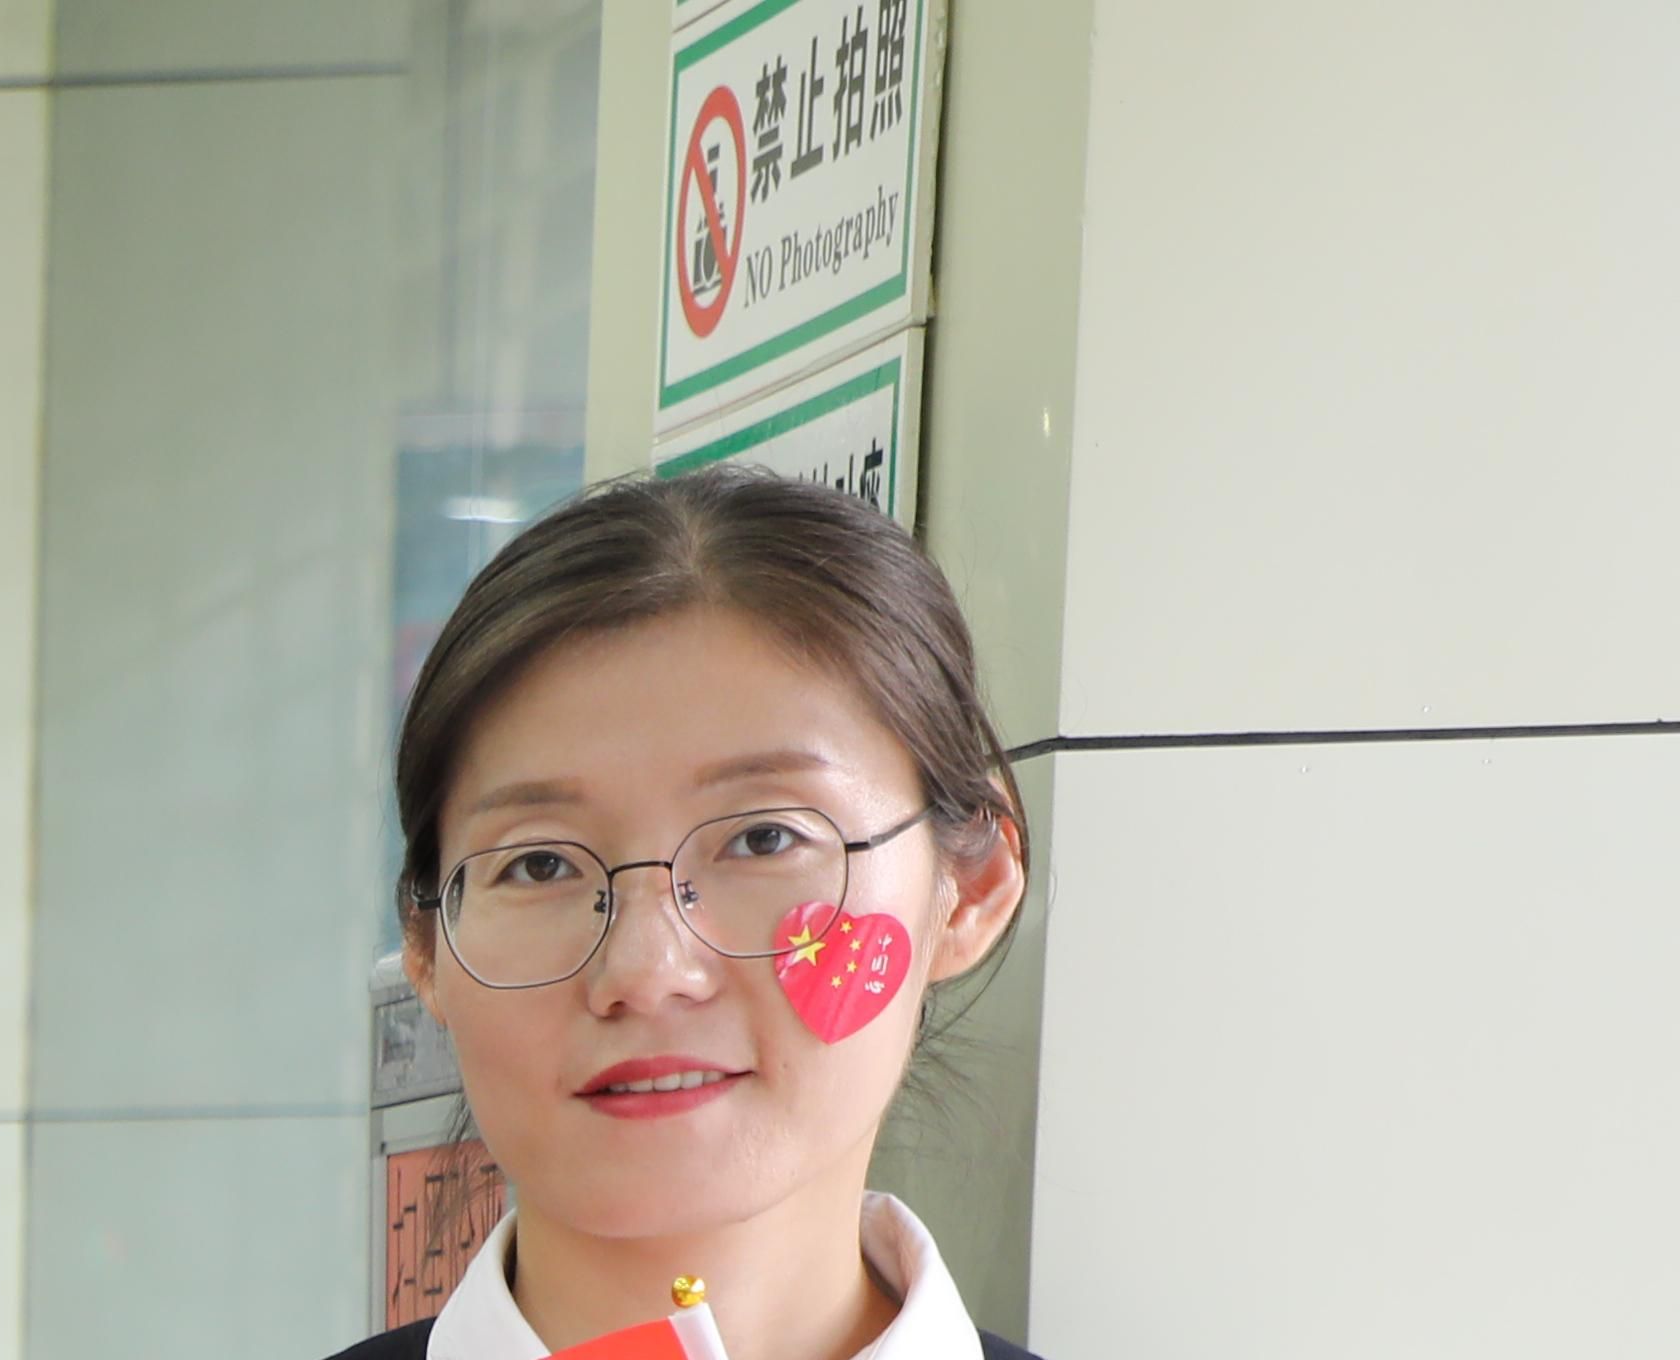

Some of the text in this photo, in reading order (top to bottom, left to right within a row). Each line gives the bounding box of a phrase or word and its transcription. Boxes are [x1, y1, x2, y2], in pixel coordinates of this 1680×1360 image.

[750, 0, 907, 204] 禁止拍照
[743, 184, 900, 309] NO Photography
